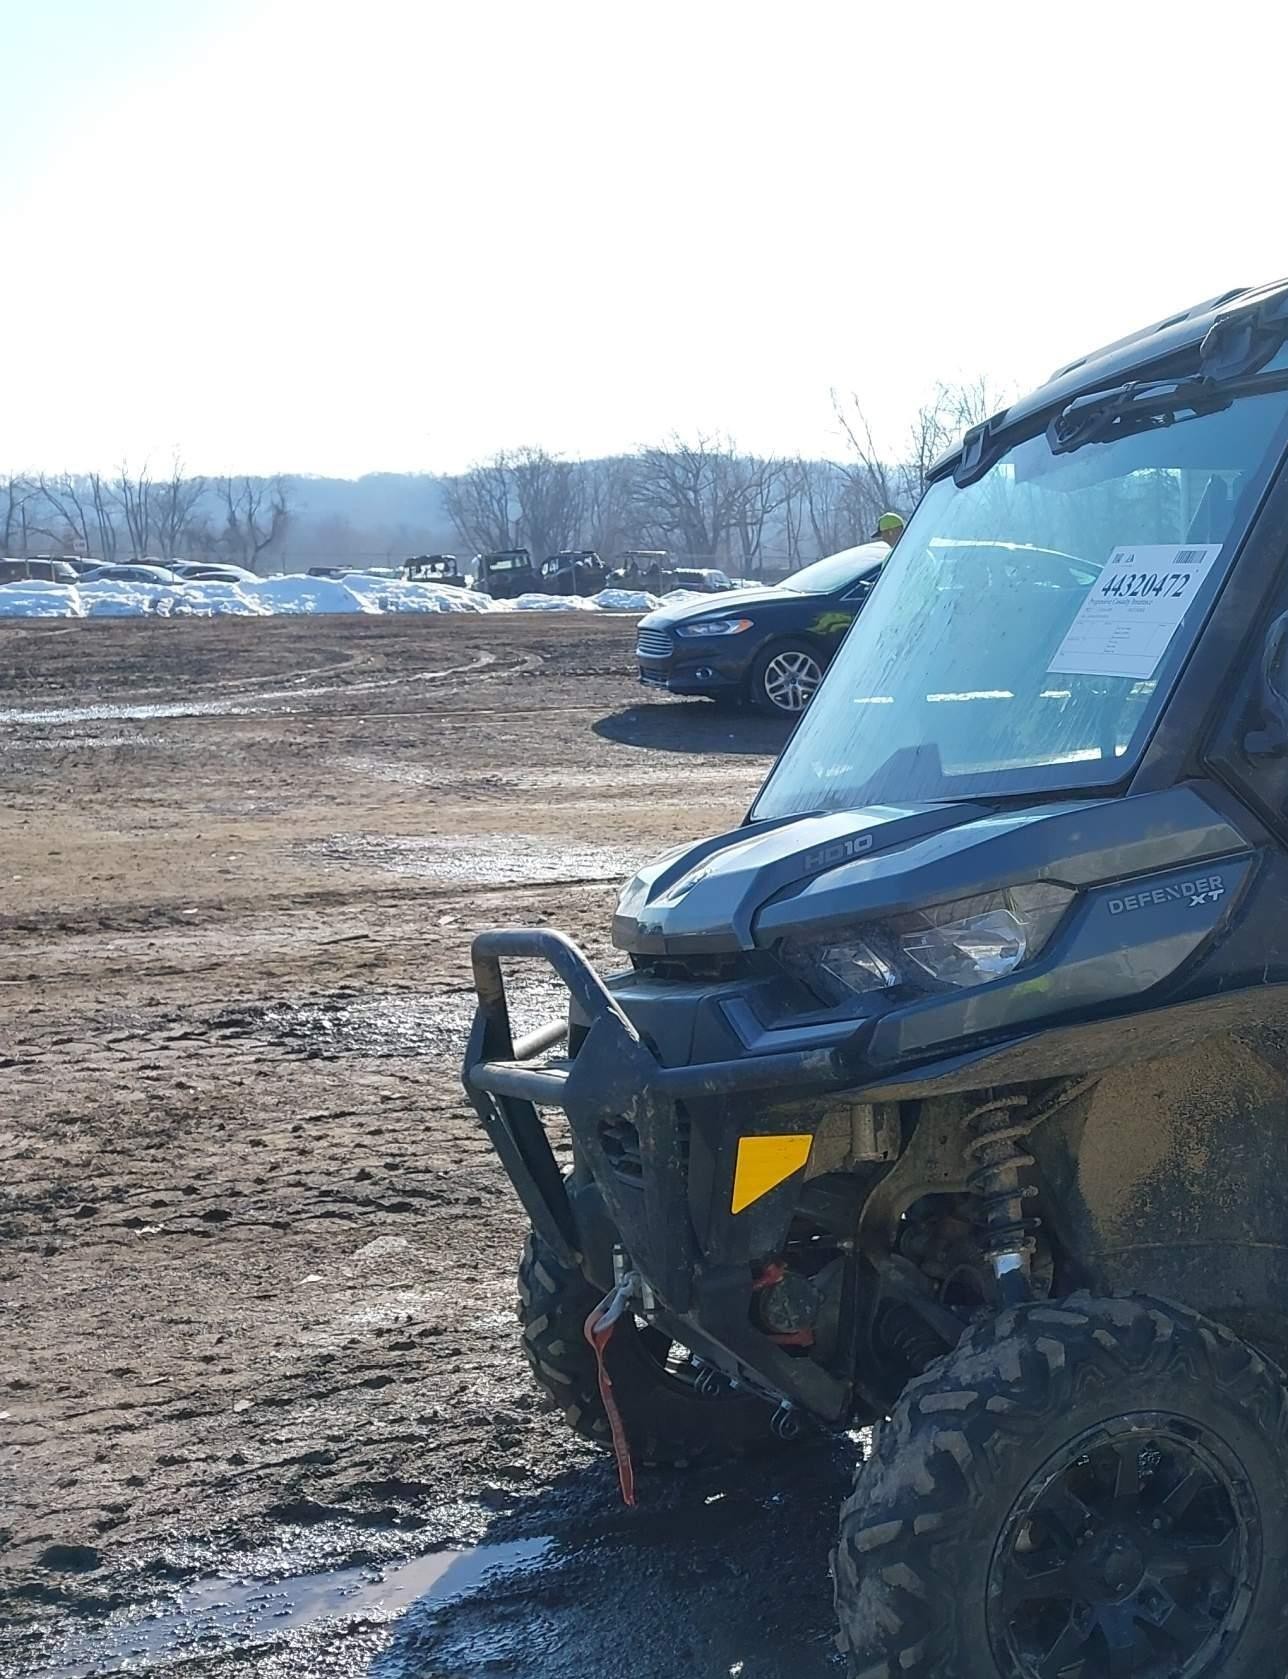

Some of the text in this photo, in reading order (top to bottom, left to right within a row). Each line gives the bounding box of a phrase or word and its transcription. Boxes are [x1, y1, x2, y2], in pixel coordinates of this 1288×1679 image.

[1101, 572, 1191, 598] 44320472
[804, 834, 873, 869] HD10
[1108, 875, 1224, 914] DEFENDER
[1188, 889, 1225, 907] XT
